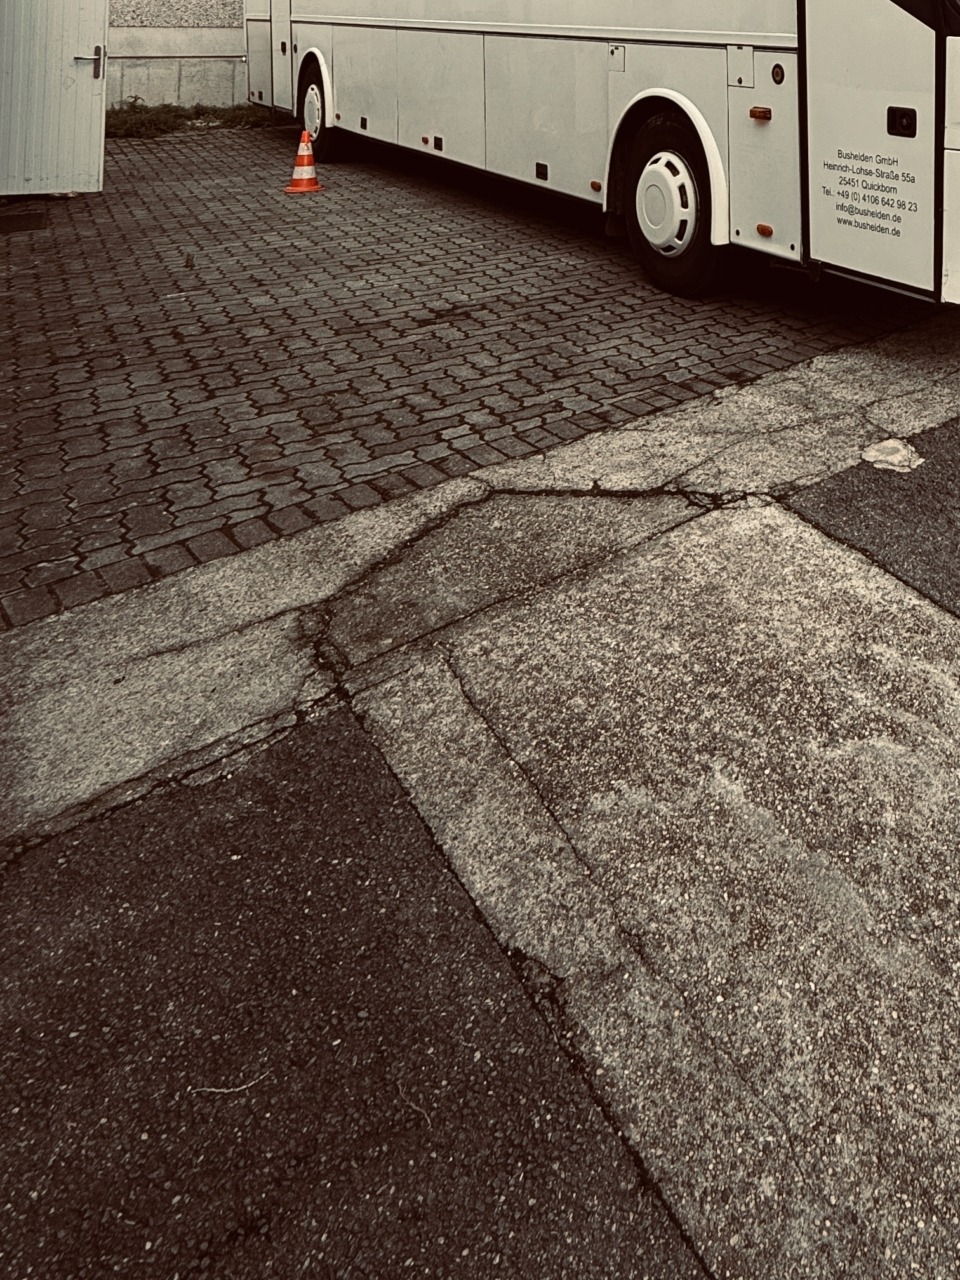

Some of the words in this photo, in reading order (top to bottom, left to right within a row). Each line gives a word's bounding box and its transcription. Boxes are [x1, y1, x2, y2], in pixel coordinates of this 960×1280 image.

[837, 149, 874, 163] Bushelden
[875, 154, 899, 166] GmbH
[823, 160, 900, 181] Heinrich-Lohse-Straße
[901, 172, 916, 184] 55a
[838, 175, 860, 188] 25451
[861, 179, 898, 195] Quickborn
[836, 189, 850, 200] +49
[851, 191, 861, 204] (0)
[861, 193, 880, 205] 4106
[881, 196, 895, 208] 642
[896, 199, 907, 210] 98
[907, 201, 918, 213] 23
